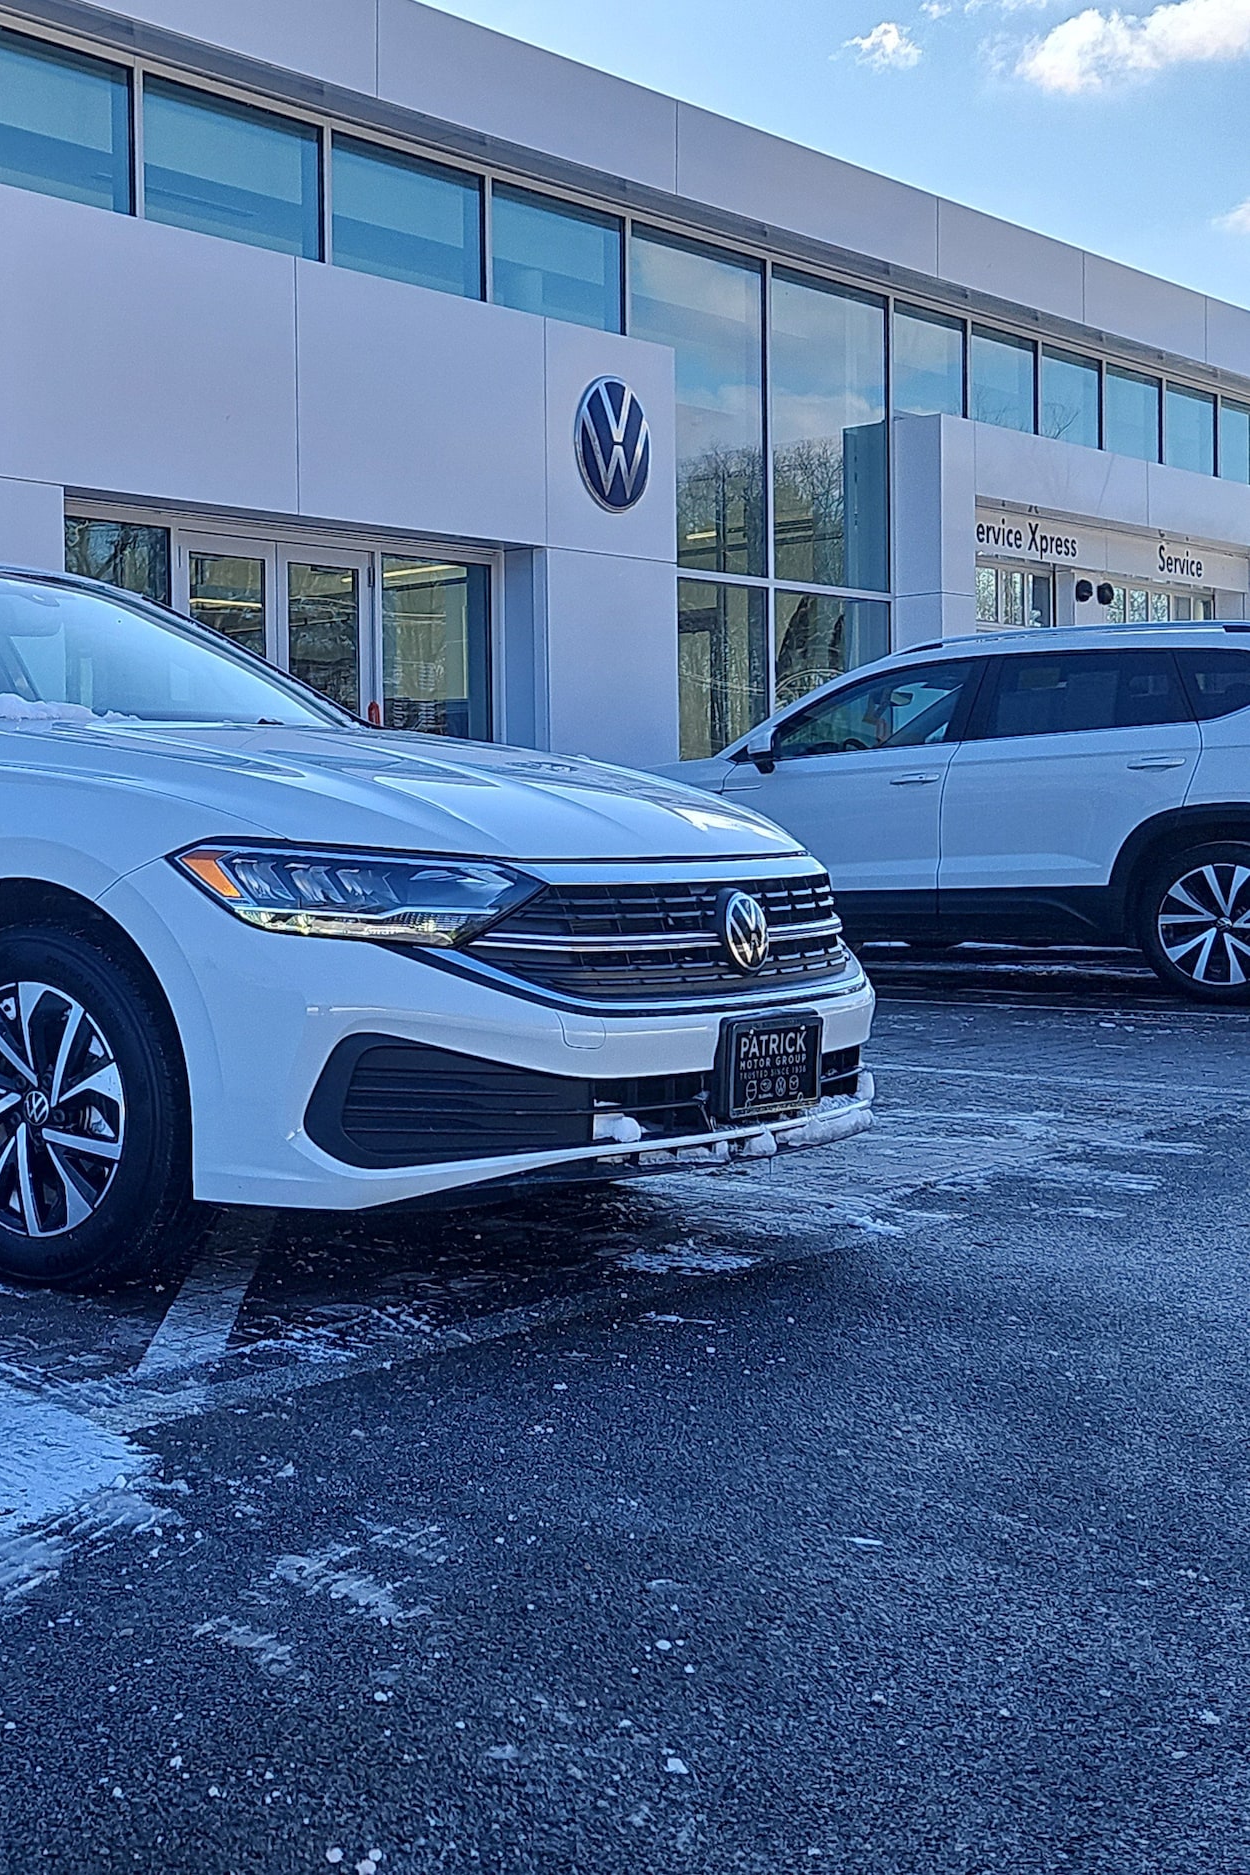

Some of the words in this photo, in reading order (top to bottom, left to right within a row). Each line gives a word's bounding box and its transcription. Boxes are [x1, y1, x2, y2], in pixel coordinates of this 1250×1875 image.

[976, 518, 1022, 549] ervice
[1027, 522, 1078, 560] Xpress
[1158, 544, 1203, 578] Service
[740, 1031, 807, 1058] PATRICK
[740, 1057, 771, 1070] MOTOR
[775, 1053, 807, 1066] GROUP
[740, 1069, 768, 1080] TRUSTED
[770, 1066, 790, 1077] SINCE
